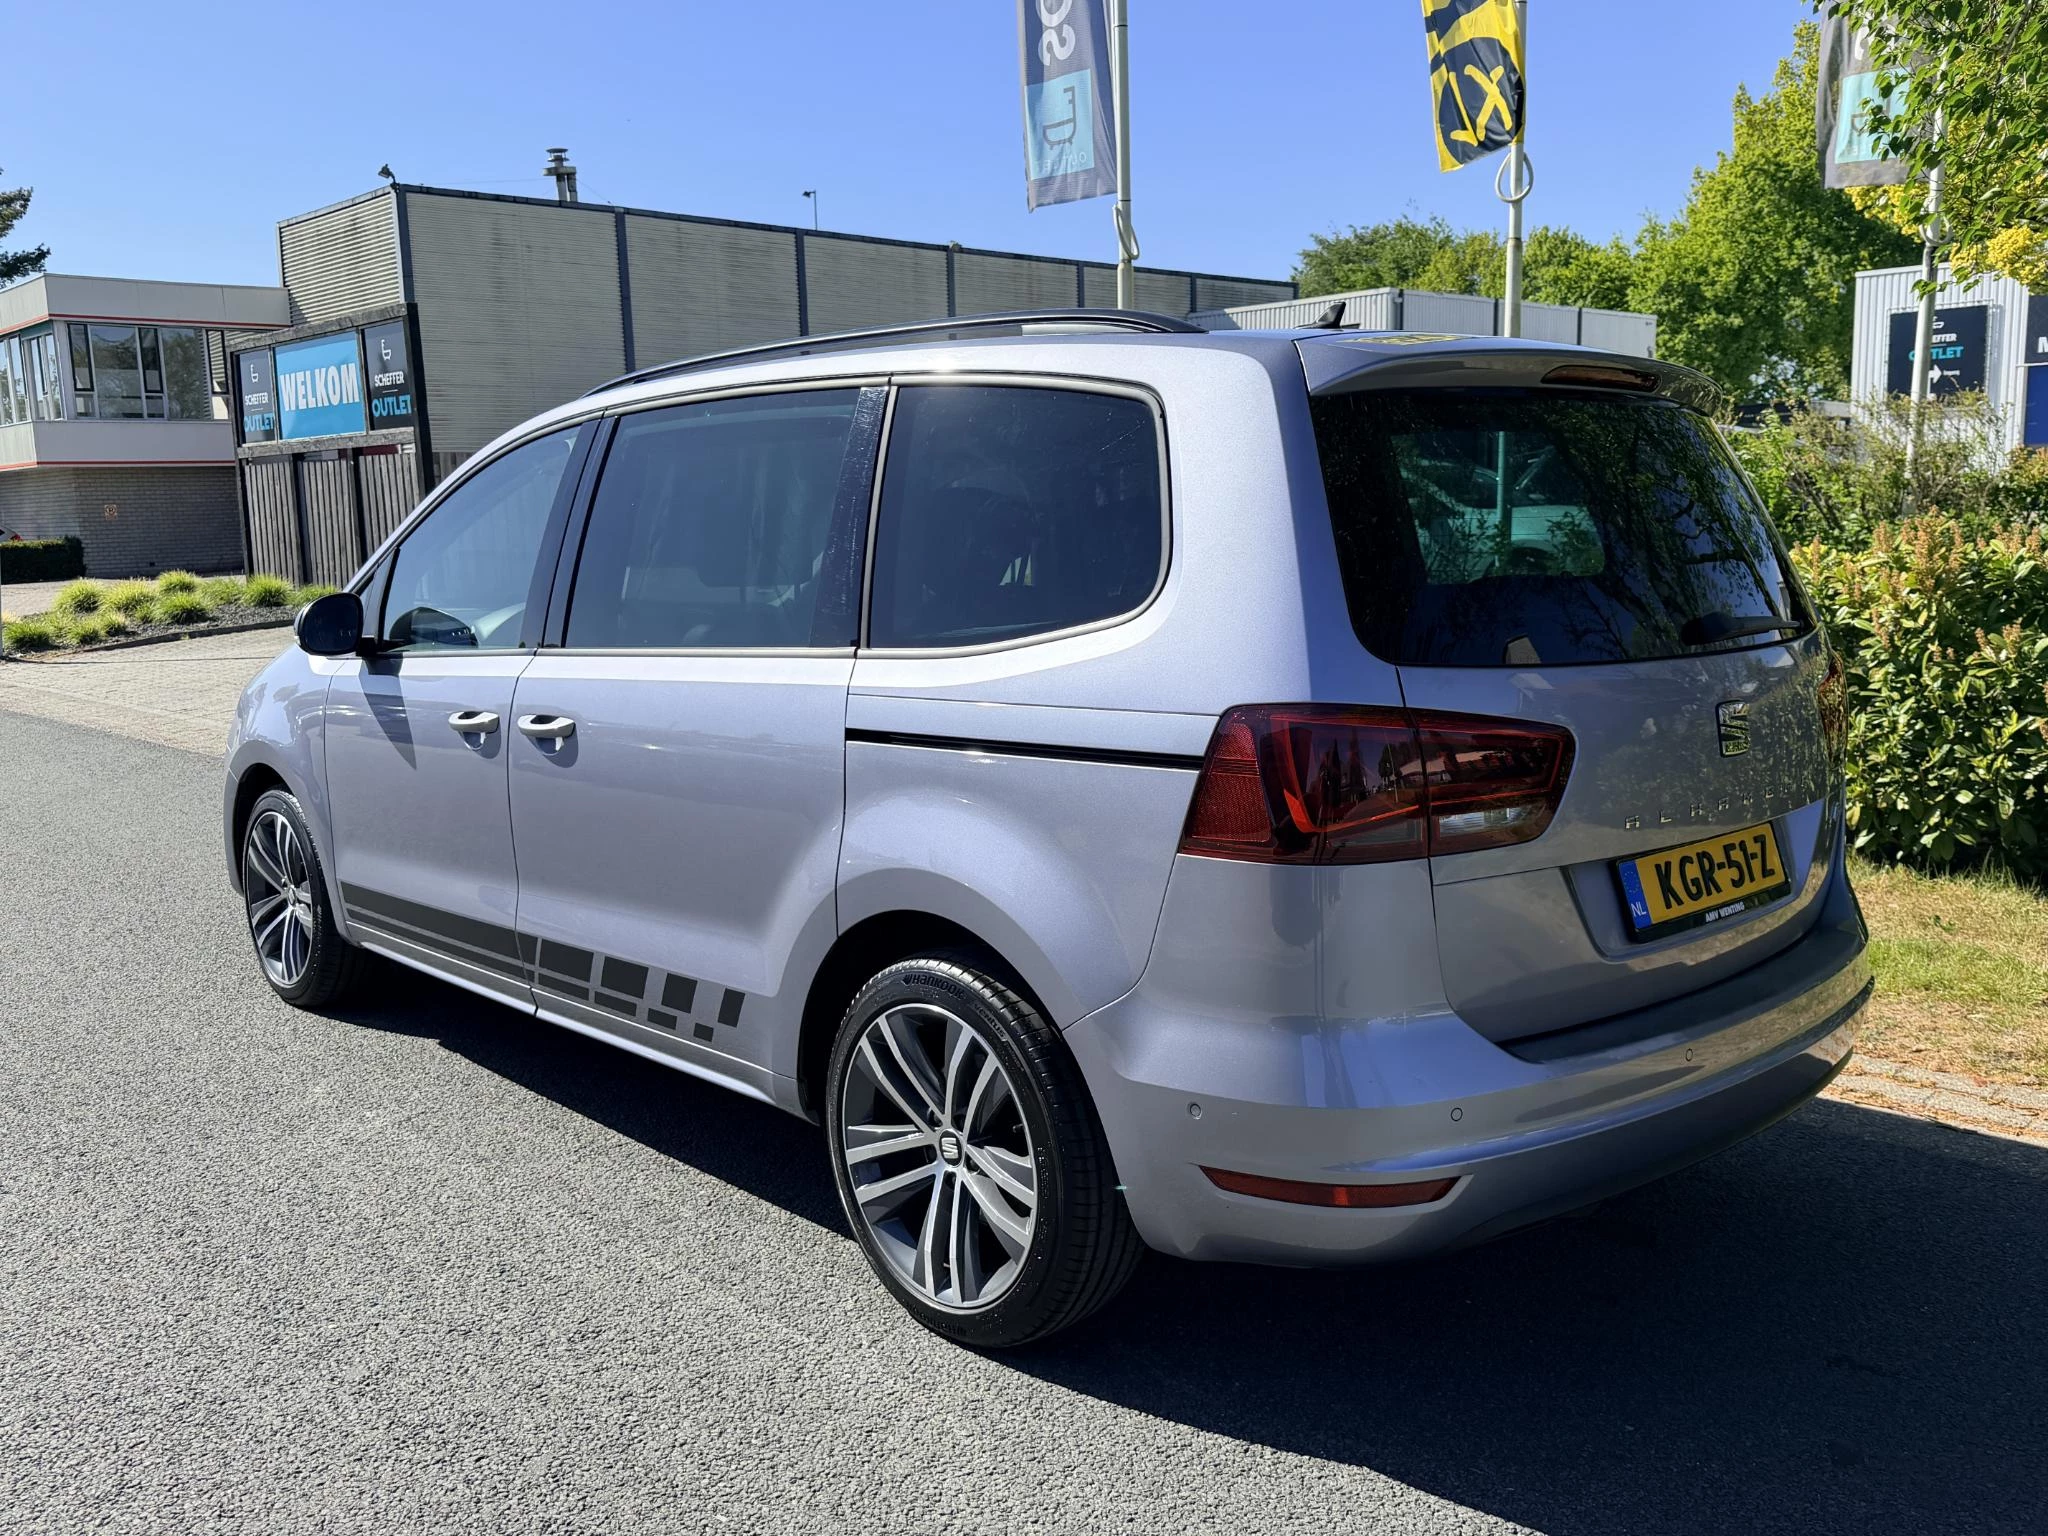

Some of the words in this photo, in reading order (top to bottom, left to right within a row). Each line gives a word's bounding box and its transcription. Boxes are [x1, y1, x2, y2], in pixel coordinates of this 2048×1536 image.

[1908, 345, 1964, 361] OTLET
[280, 363, 360, 411] WELKOM
[374, 371, 405, 387] SCHEFFER
[244, 392, 269, 406] SCHEFFER
[371, 394, 412, 417] OUTLET
[243, 412, 275, 433] OUTLET
[1654, 834, 1776, 910] KGR-51-Z
[1630, 901, 1647, 917] NL
